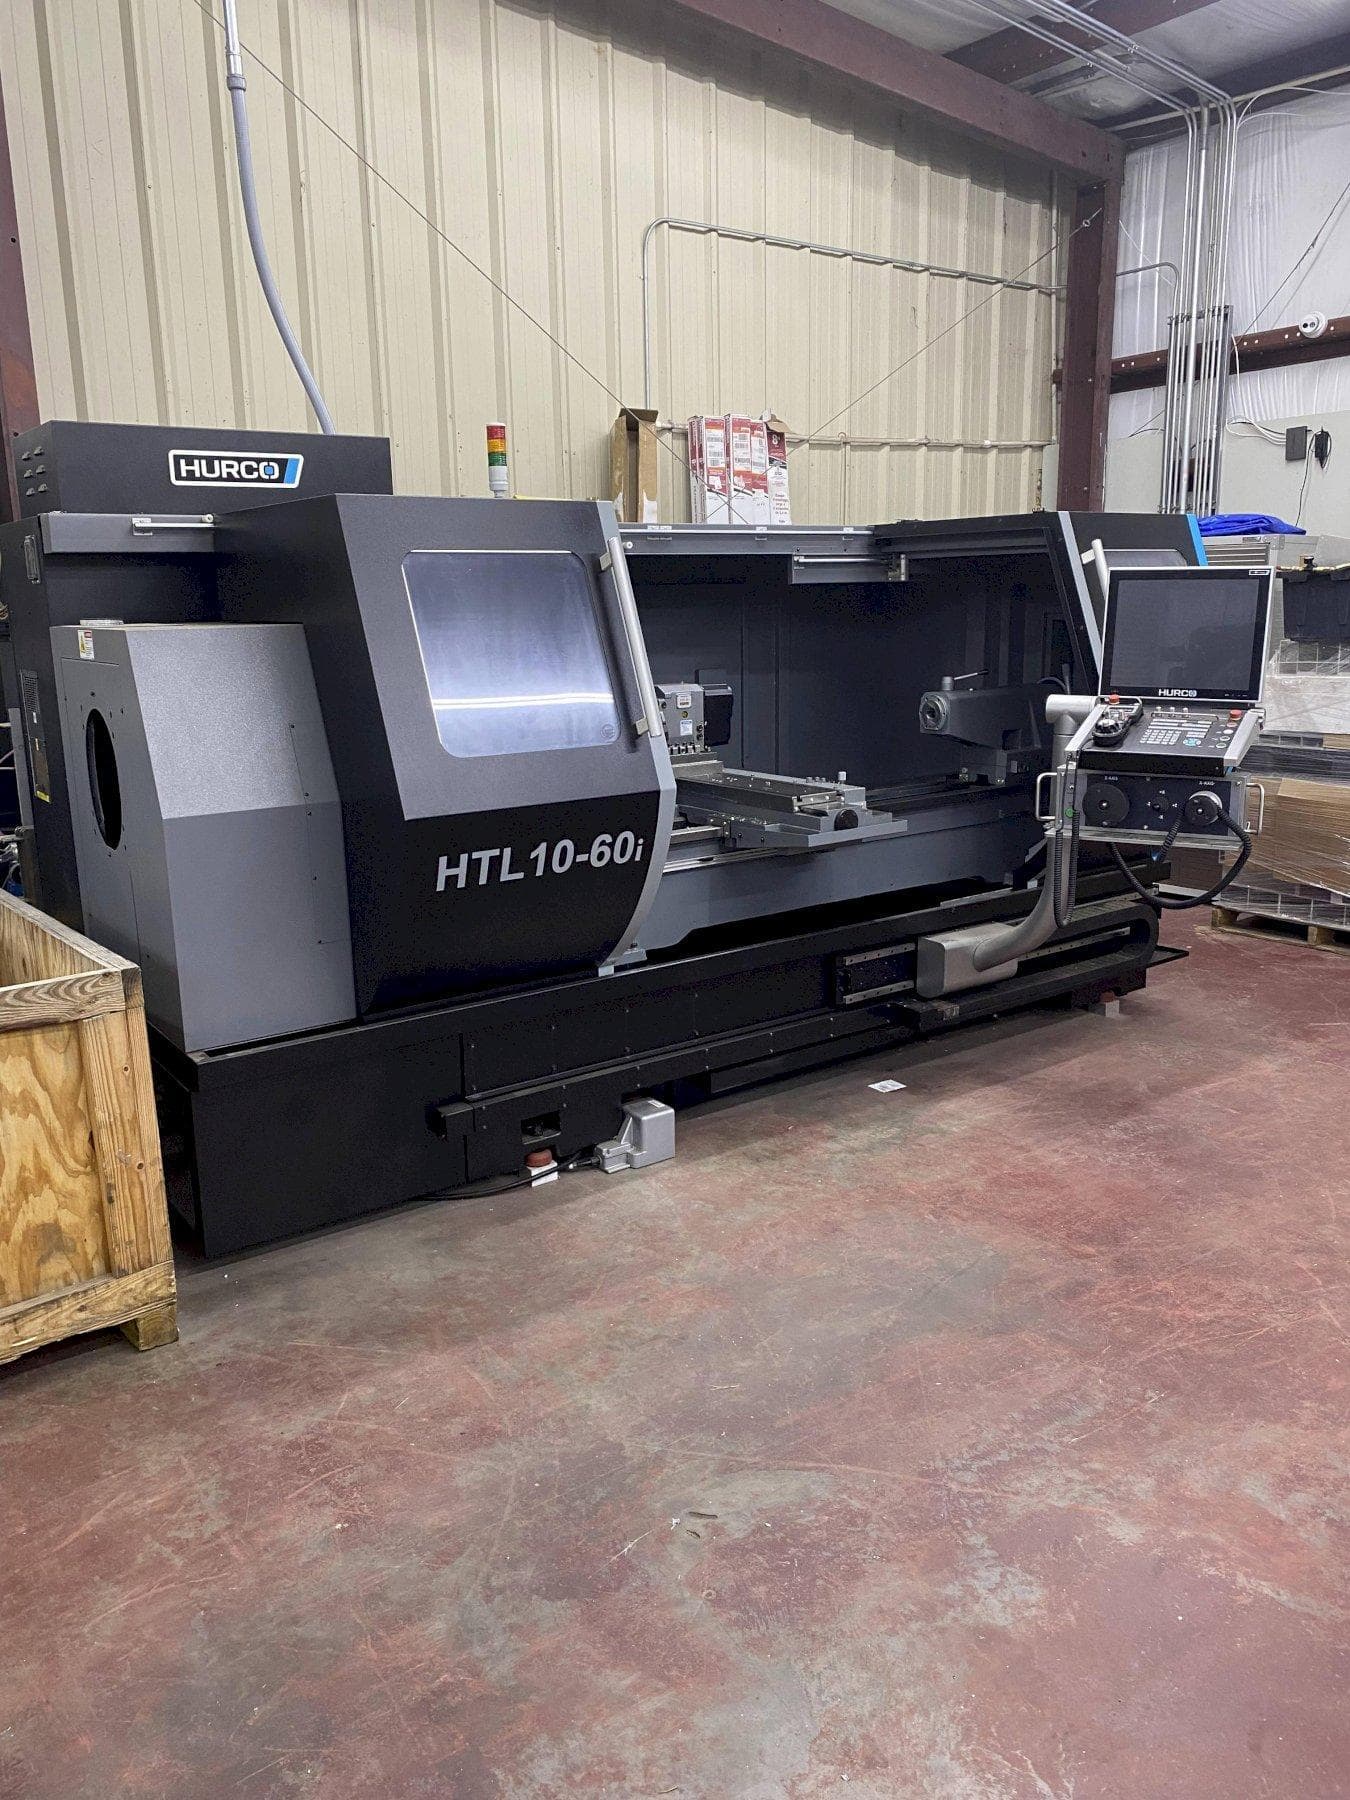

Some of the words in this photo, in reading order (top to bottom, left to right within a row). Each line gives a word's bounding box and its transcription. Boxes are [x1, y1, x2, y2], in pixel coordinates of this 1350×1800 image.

[179, 458, 280, 480] HURCO
[1158, 688, 1197, 697] HURCO
[436, 847, 525, 892] HTL
[529, 830, 644, 877] 10-60i
